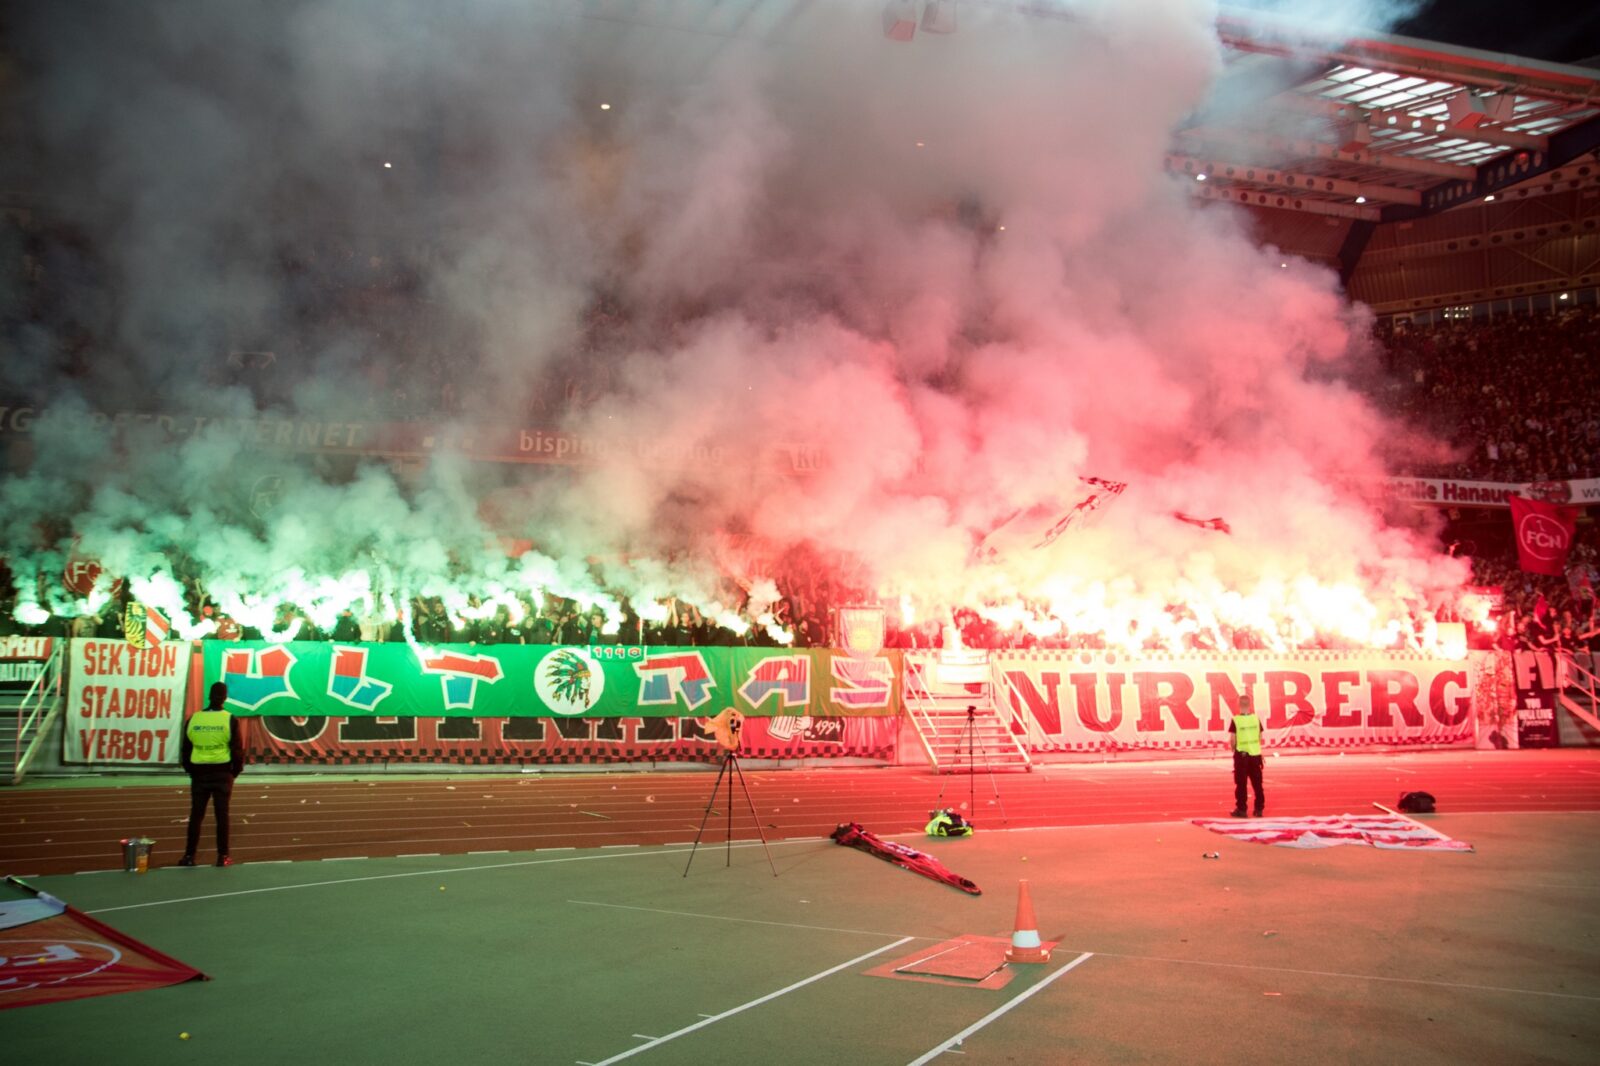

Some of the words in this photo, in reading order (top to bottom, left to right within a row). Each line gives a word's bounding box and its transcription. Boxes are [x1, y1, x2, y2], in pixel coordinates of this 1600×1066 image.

[1526, 530, 1563, 549] FCN
[83, 641, 177, 677] SEKTION
[80, 685, 173, 719] STADION
[1003, 651, 1472, 735] NÜRNBERG
[814, 719, 842, 736] 1994
[79, 728, 170, 762] VERBOT
